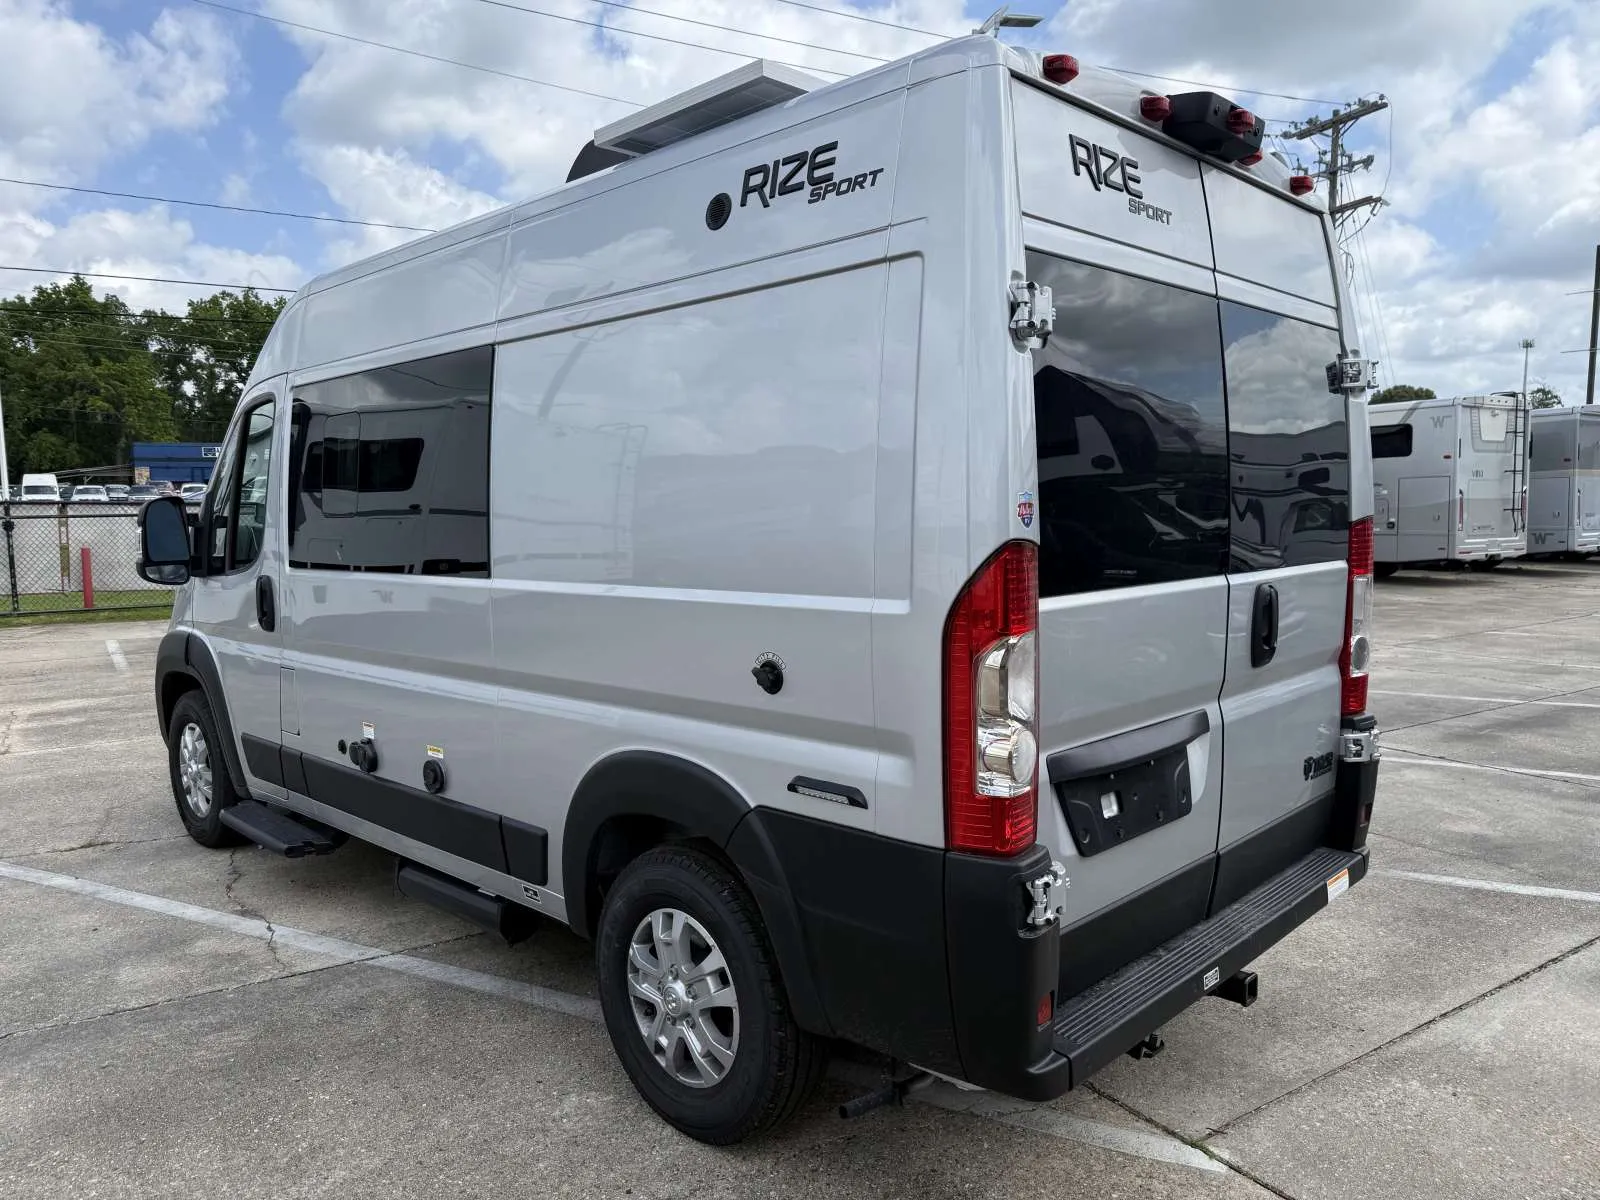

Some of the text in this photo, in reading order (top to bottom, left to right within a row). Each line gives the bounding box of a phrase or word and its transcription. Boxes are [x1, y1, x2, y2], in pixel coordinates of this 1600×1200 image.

[740, 140, 839, 208] RIZE
[807, 168, 885, 205] SPORT
[1068, 133, 1144, 200] RIZE
[1128, 198, 1173, 225] SPORT
